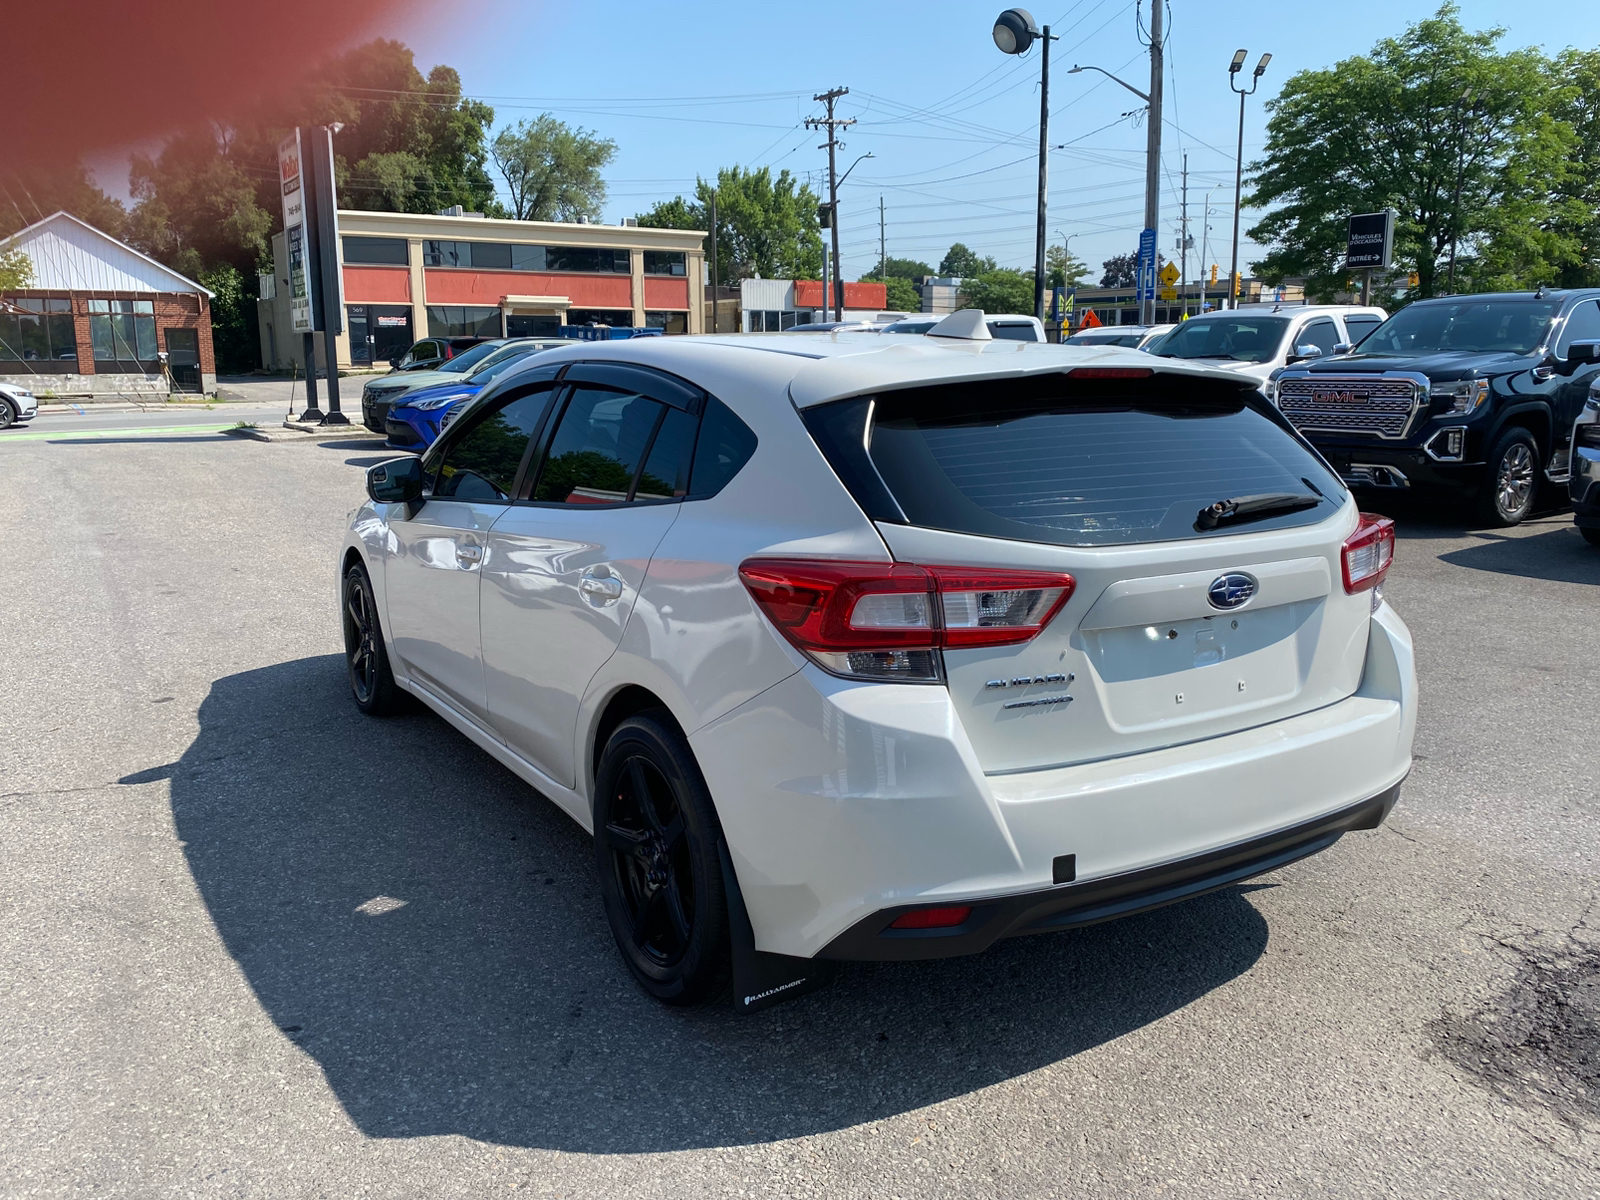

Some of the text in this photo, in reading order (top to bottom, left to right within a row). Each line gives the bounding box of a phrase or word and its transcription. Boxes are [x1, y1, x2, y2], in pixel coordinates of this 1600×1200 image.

[1348, 254, 1373, 263] ENTRÉE
[1313, 391, 1368, 403] GMC
[985, 672, 1075, 690] SUBARU
